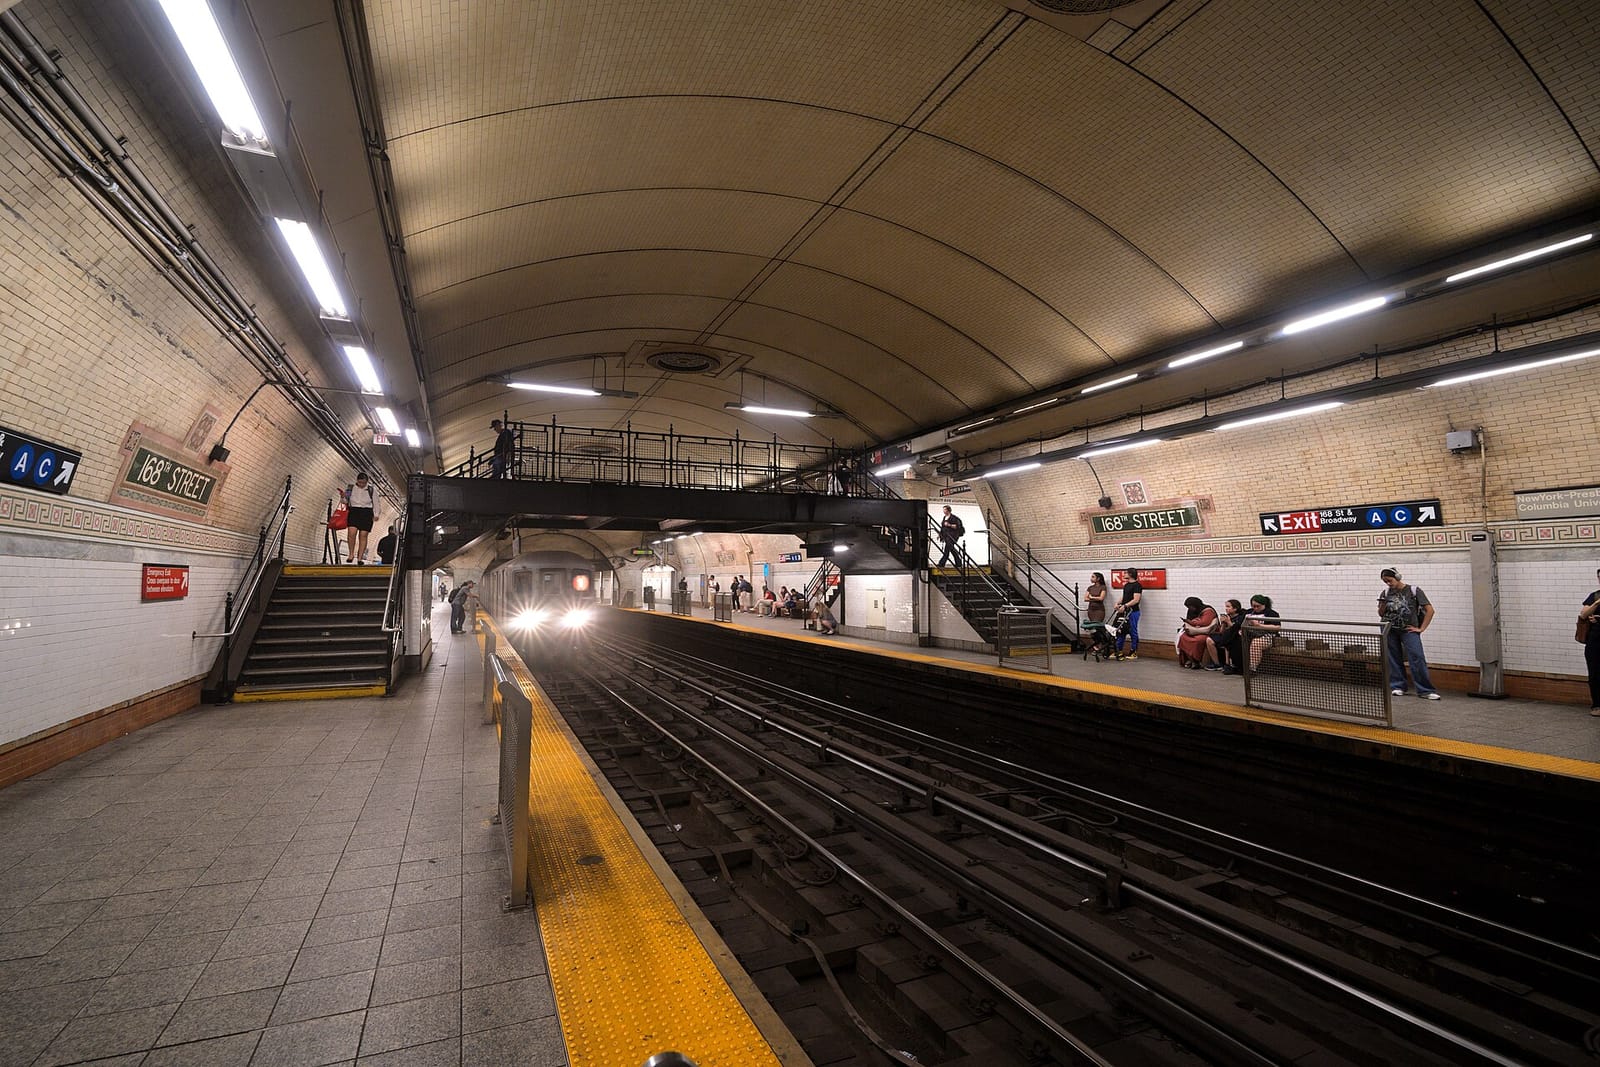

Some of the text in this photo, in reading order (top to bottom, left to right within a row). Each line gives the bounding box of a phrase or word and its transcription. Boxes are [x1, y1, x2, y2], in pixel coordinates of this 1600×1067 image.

[14, 452, 51, 478] A C
[167, 467, 211, 500] STREET
[1320, 508, 1353, 518] 168 St &
[1519, 499, 1600, 512] Columbia Univ
[1132, 509, 1186, 529] STREET
[1279, 512, 1320, 531] Exit
[1320, 516, 1357, 525] Broadway
[1371, 510, 1406, 523] A C
